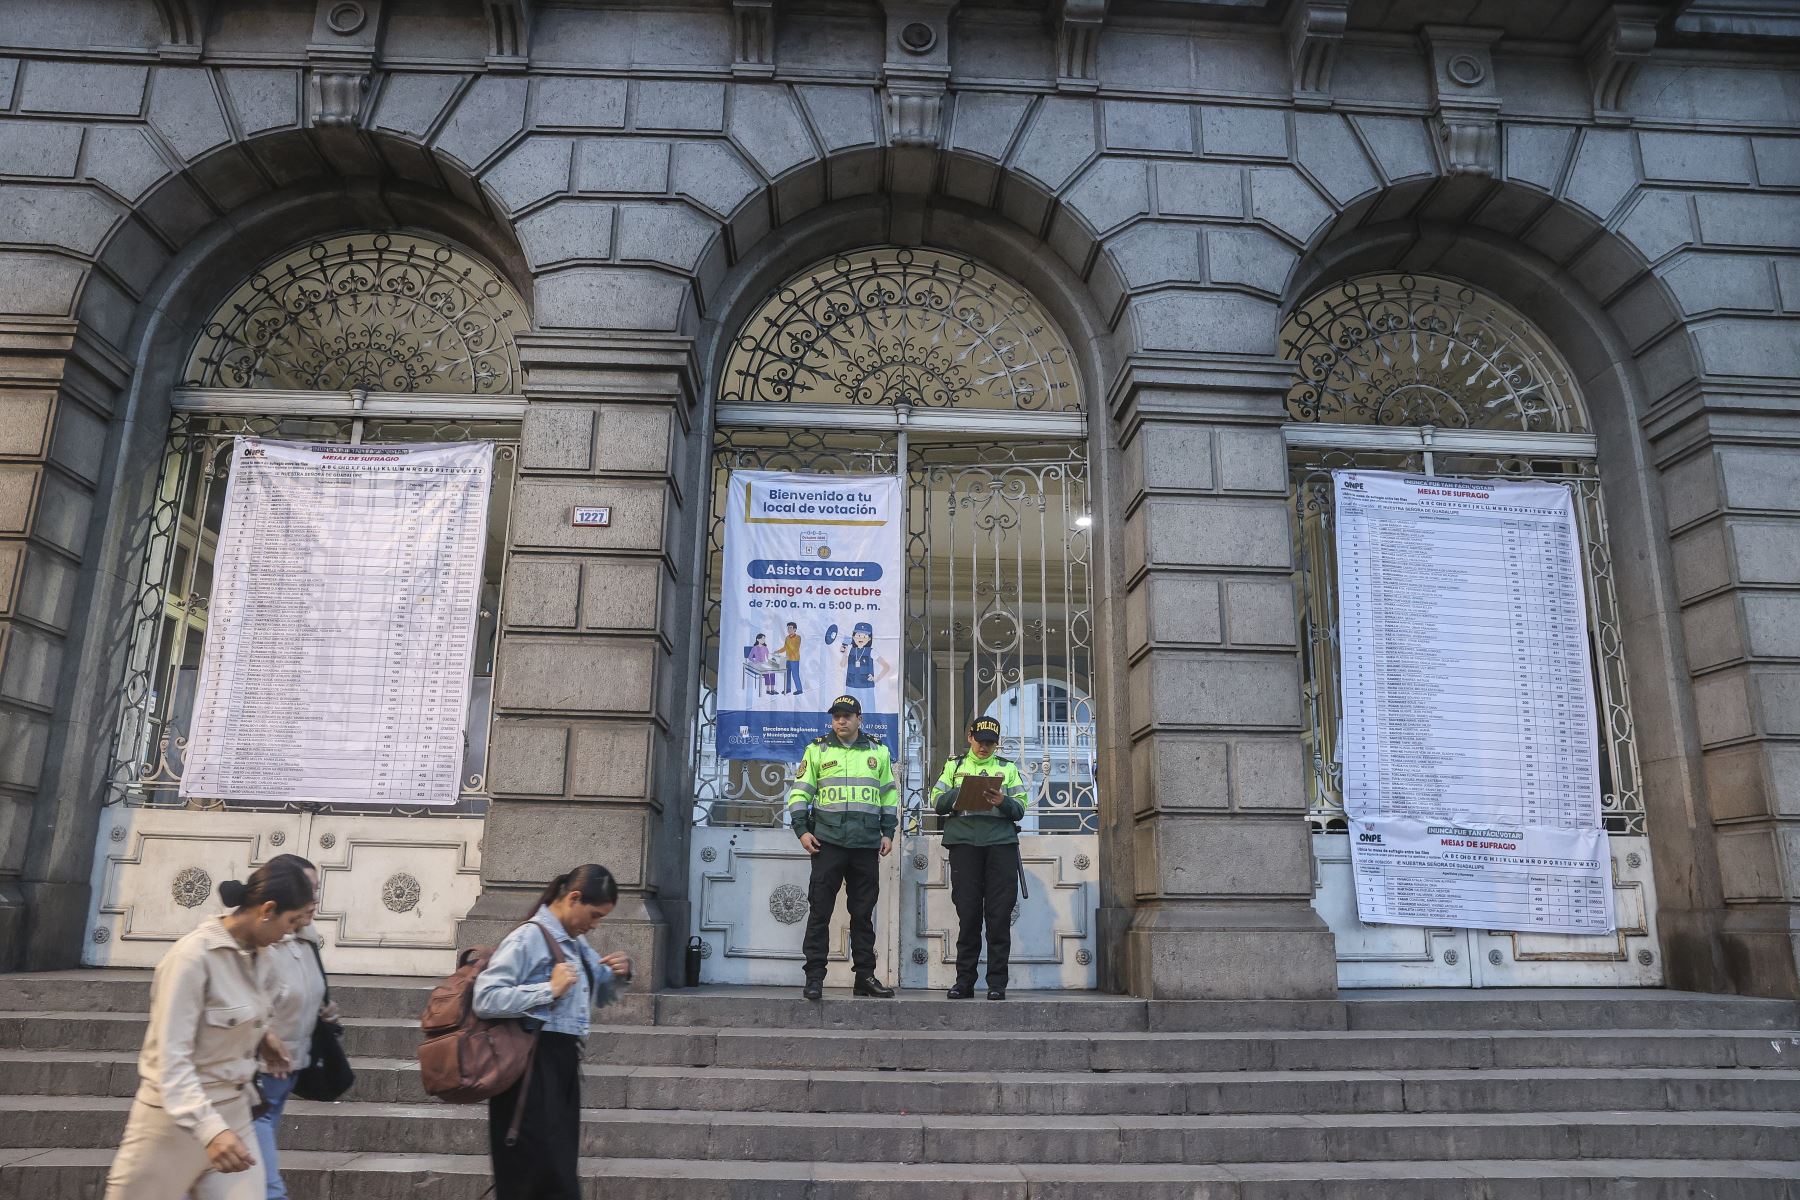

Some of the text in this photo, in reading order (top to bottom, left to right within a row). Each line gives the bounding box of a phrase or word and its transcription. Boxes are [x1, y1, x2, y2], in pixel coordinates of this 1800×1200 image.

[1344, 481, 1364, 489] ONPE
[769, 489, 872, 502] Bienvenido a tu
[1454, 491, 1490, 499] SUFRAGIO
[763, 502, 877, 515] local de votación
[579, 513, 604, 522] 1227
[765, 564, 864, 577] Asiste a votar
[747, 584, 881, 597] domingo 4 de octubre
[749, 600, 762, 608] de
[765, 600, 787, 608] 7:00
[829, 601, 852, 609] 5:00
[854, 602, 864, 612] p.
[977, 721, 999, 734] POLICIA
[729, 736, 760, 744] ONPE
[1482, 829, 1499, 837] FÁCIL
[1360, 834, 1381, 842] ONPE
[1480, 842, 1516, 850] SUFRAGIO
